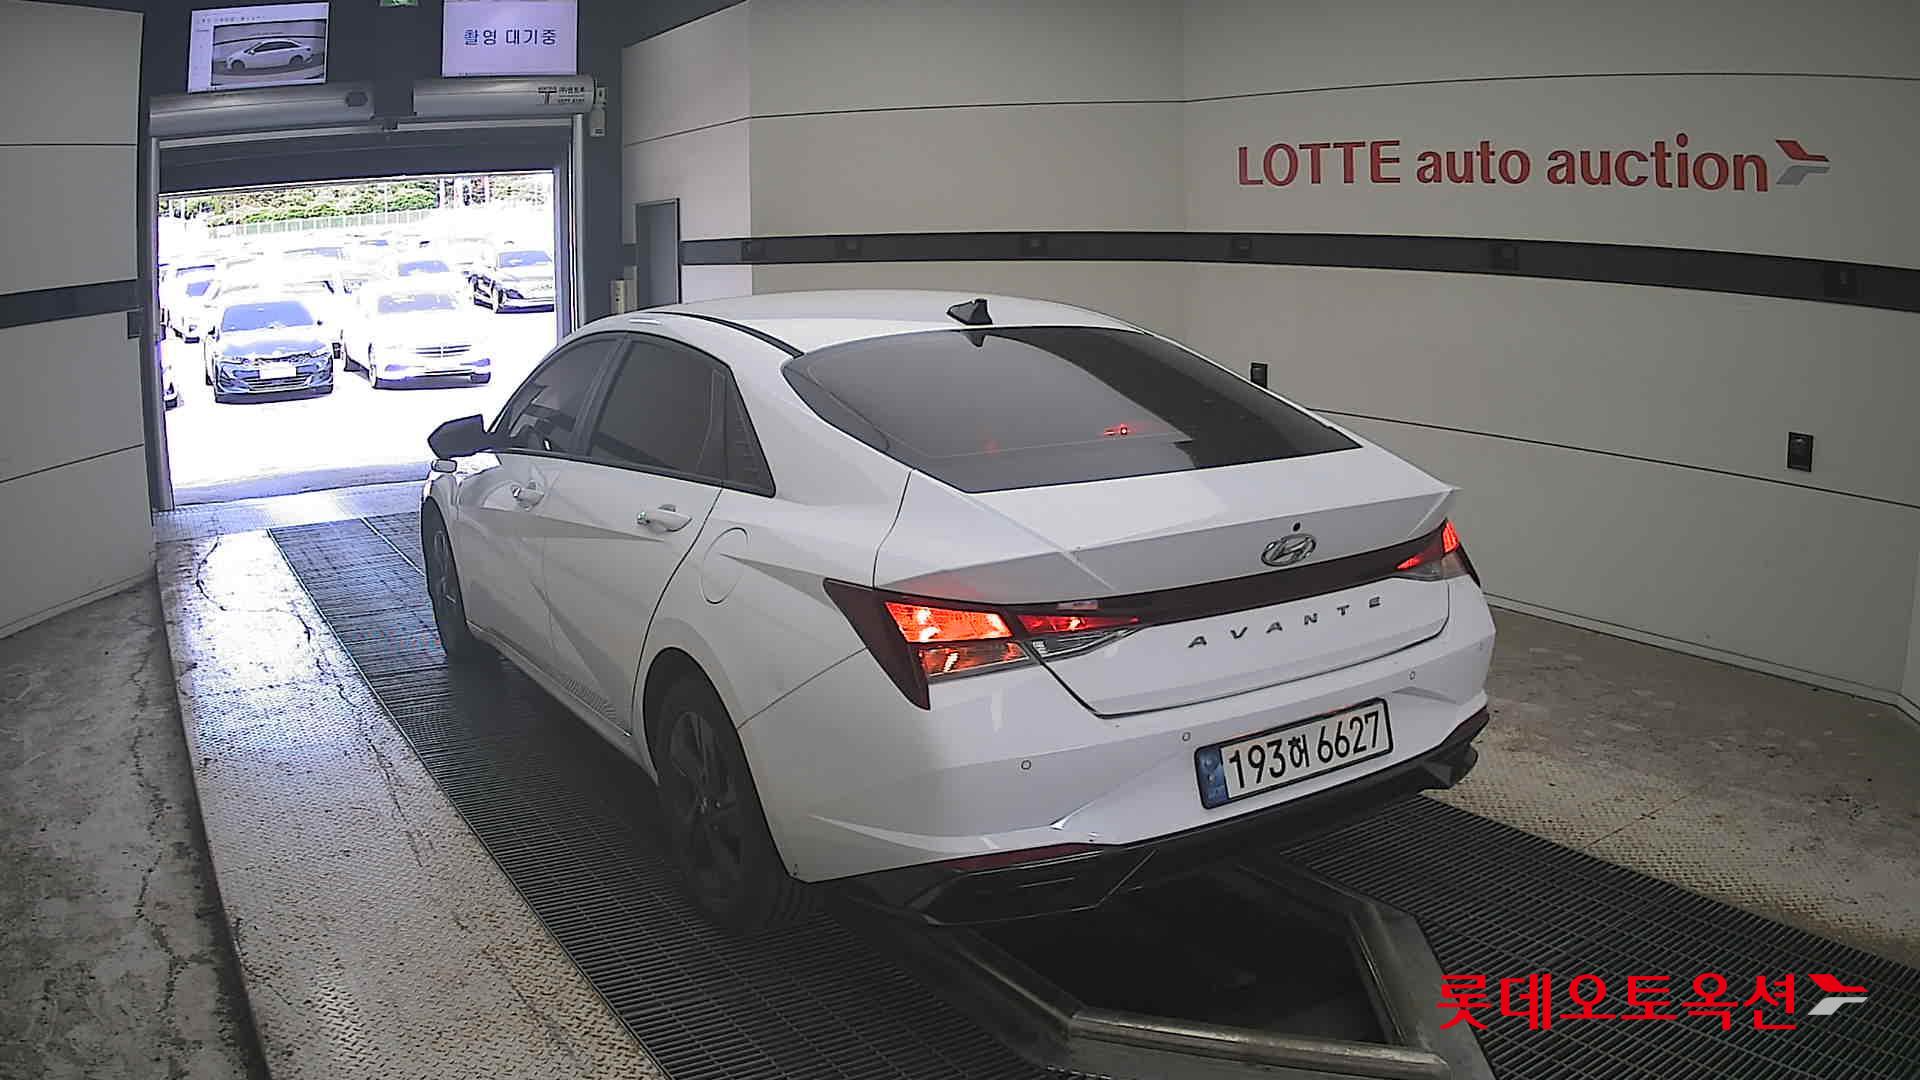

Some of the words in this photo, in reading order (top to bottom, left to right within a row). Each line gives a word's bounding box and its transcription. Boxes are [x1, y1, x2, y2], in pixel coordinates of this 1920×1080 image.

[505, 29, 557, 46] 대기중
[1237, 139, 1401, 187] LOTTE
[1415, 139, 1532, 185] auto
[1545, 132, 1769, 192] auction
[1188, 596, 1381, 649] AVANTE
[1317, 710, 1379, 764] 6627
